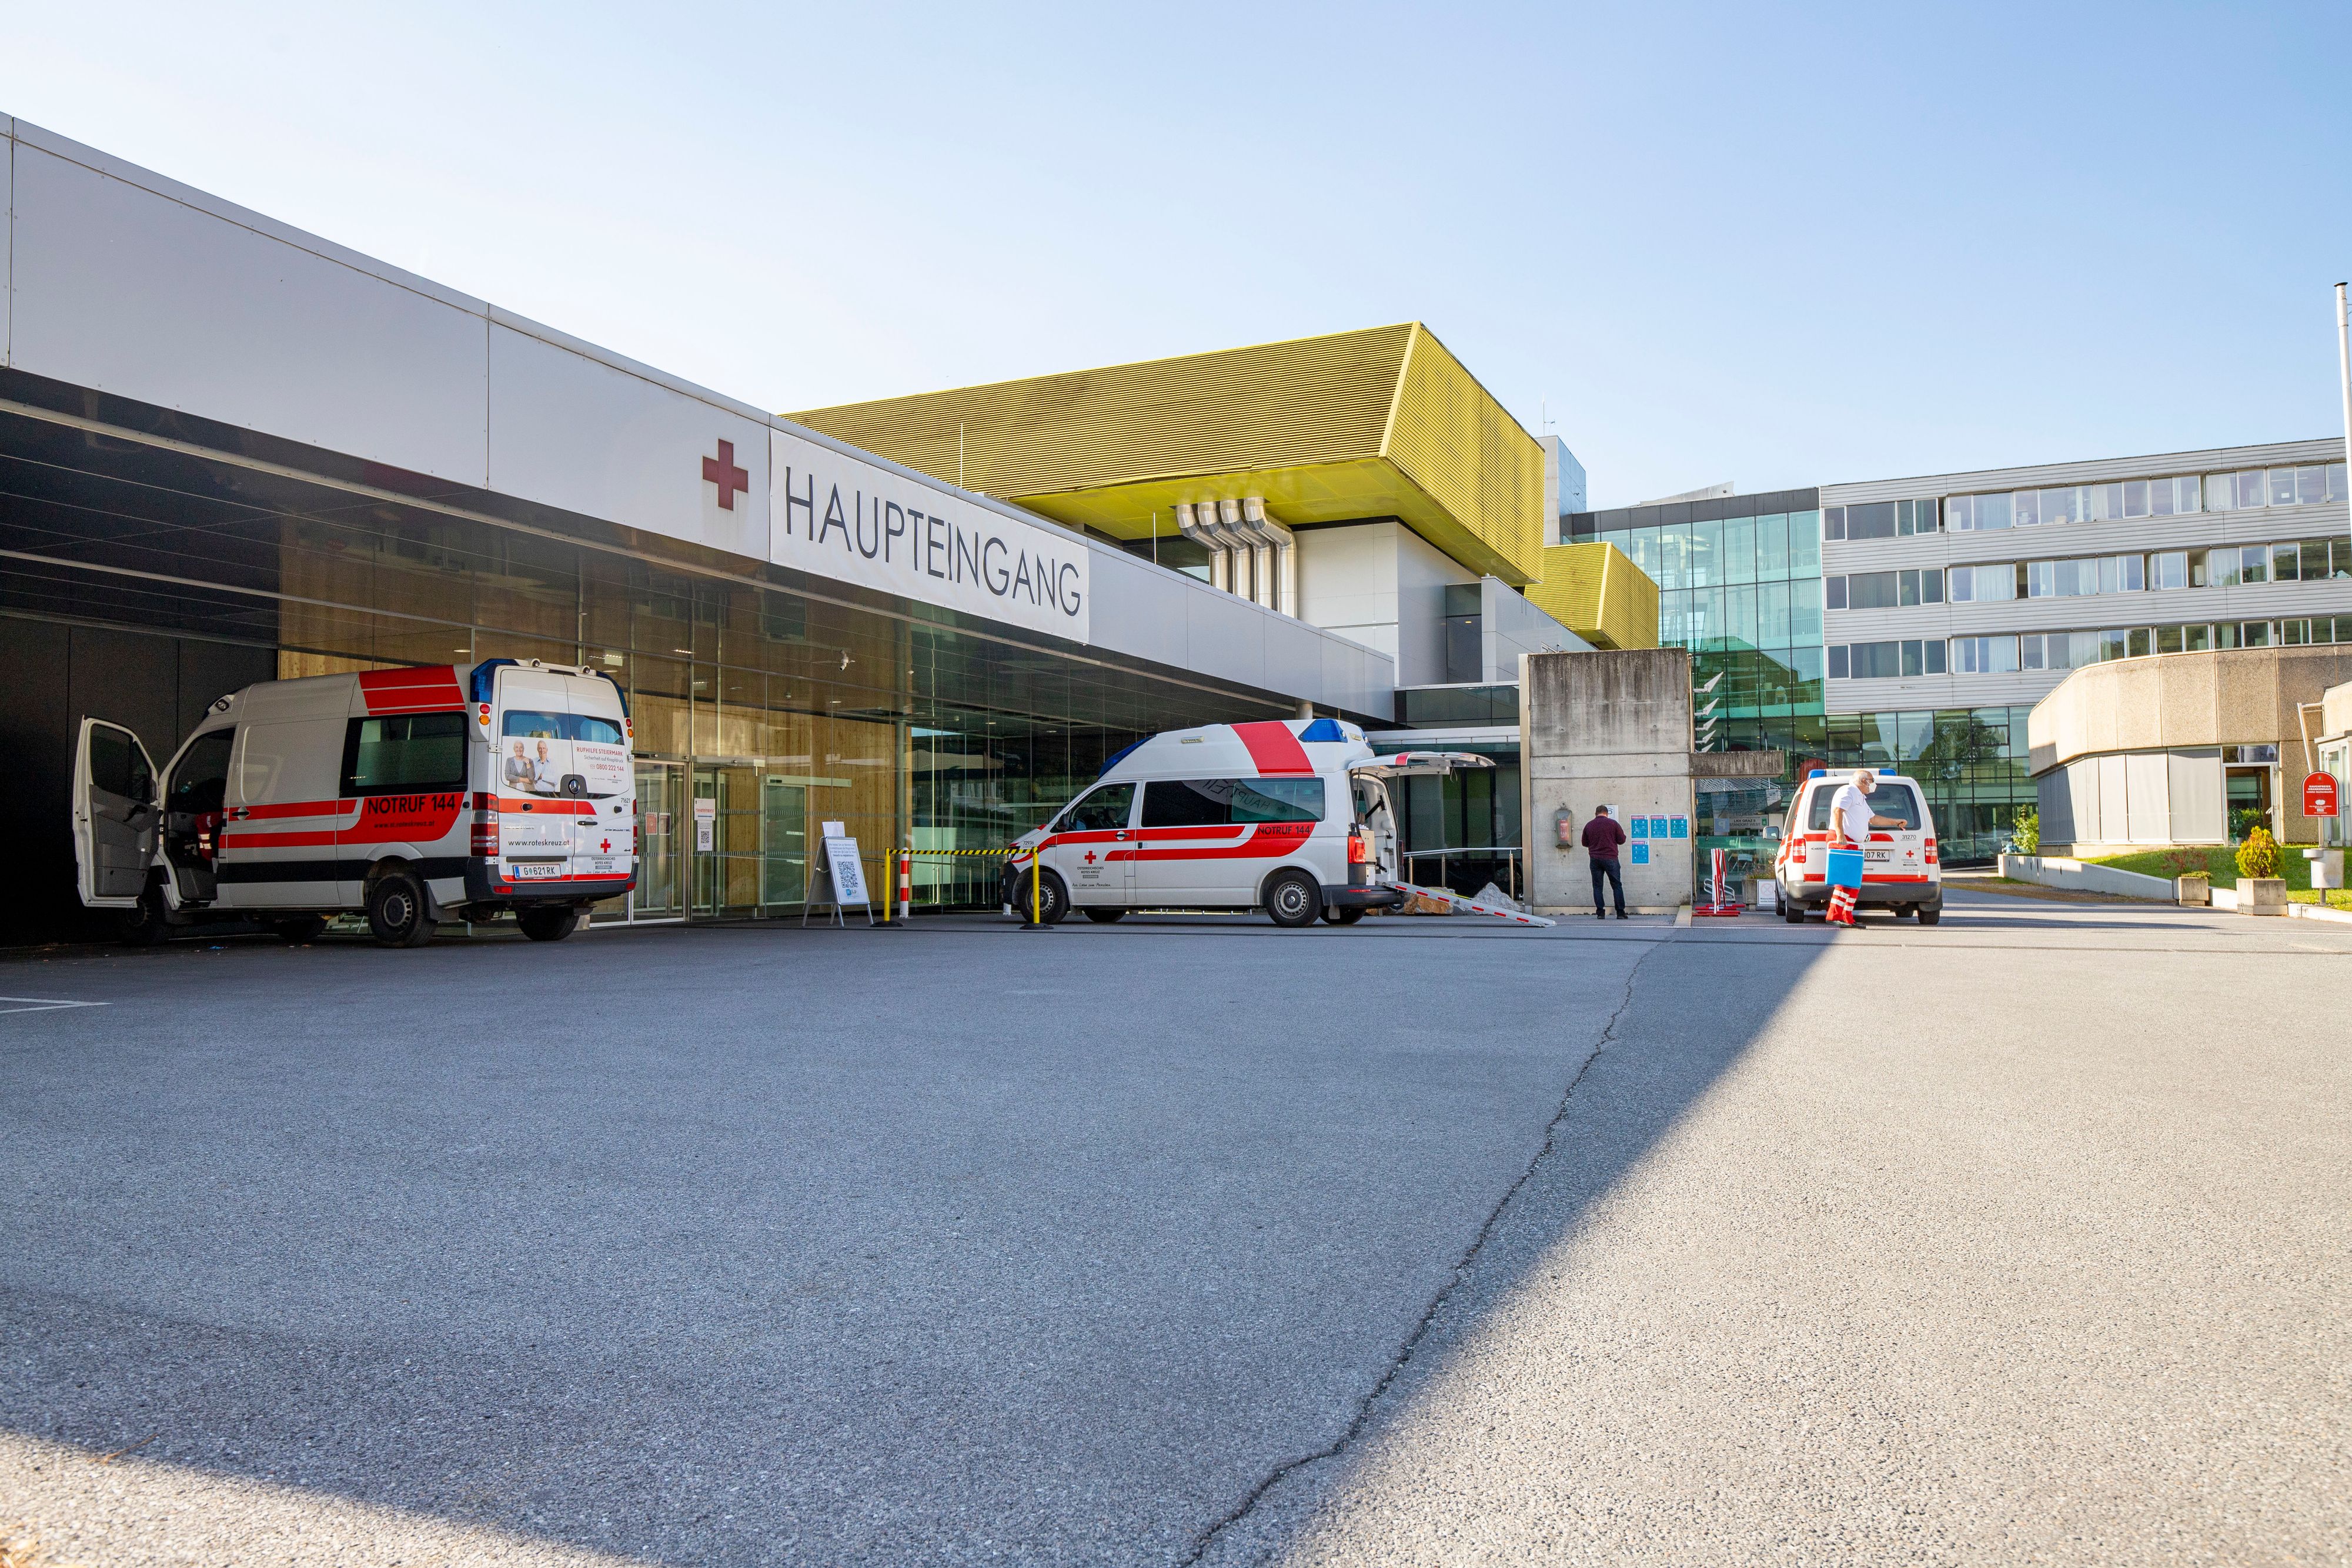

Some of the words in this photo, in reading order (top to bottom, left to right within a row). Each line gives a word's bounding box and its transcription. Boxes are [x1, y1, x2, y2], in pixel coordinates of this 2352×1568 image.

[786, 466, 1081, 617] HAUPTEINGANG
[368, 796, 426, 814] NOTRUF
[432, 795, 455, 811] 144
[1258, 826, 1292, 835] NOTRUF
[1295, 825, 1311, 834] 144
